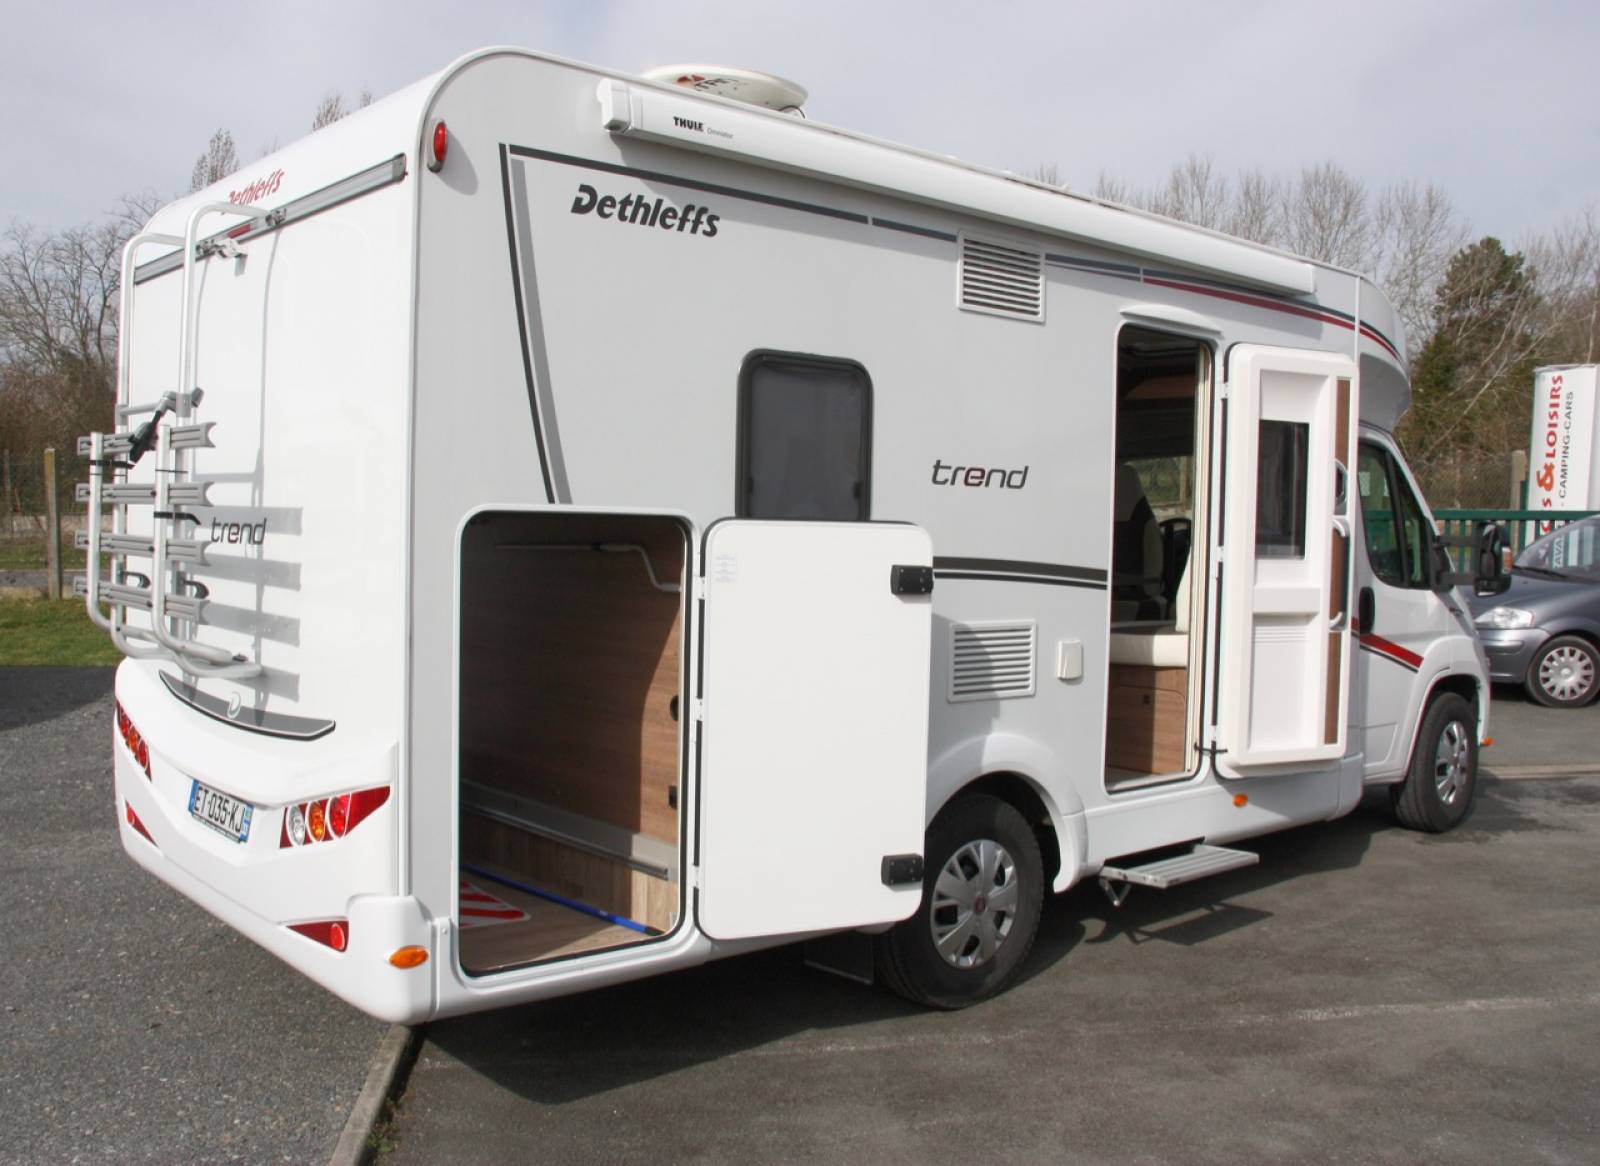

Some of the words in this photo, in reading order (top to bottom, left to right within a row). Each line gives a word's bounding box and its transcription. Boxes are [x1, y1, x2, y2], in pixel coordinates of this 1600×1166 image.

[673, 116, 704, 132] THULE
[571, 184, 720, 238] Dethleffs
[1545, 375, 1564, 458] LOISIRS
[1559, 391, 1574, 499] CAMPING-CARS
[931, 459, 1029, 489] trend
[211, 516, 267, 545] trend
